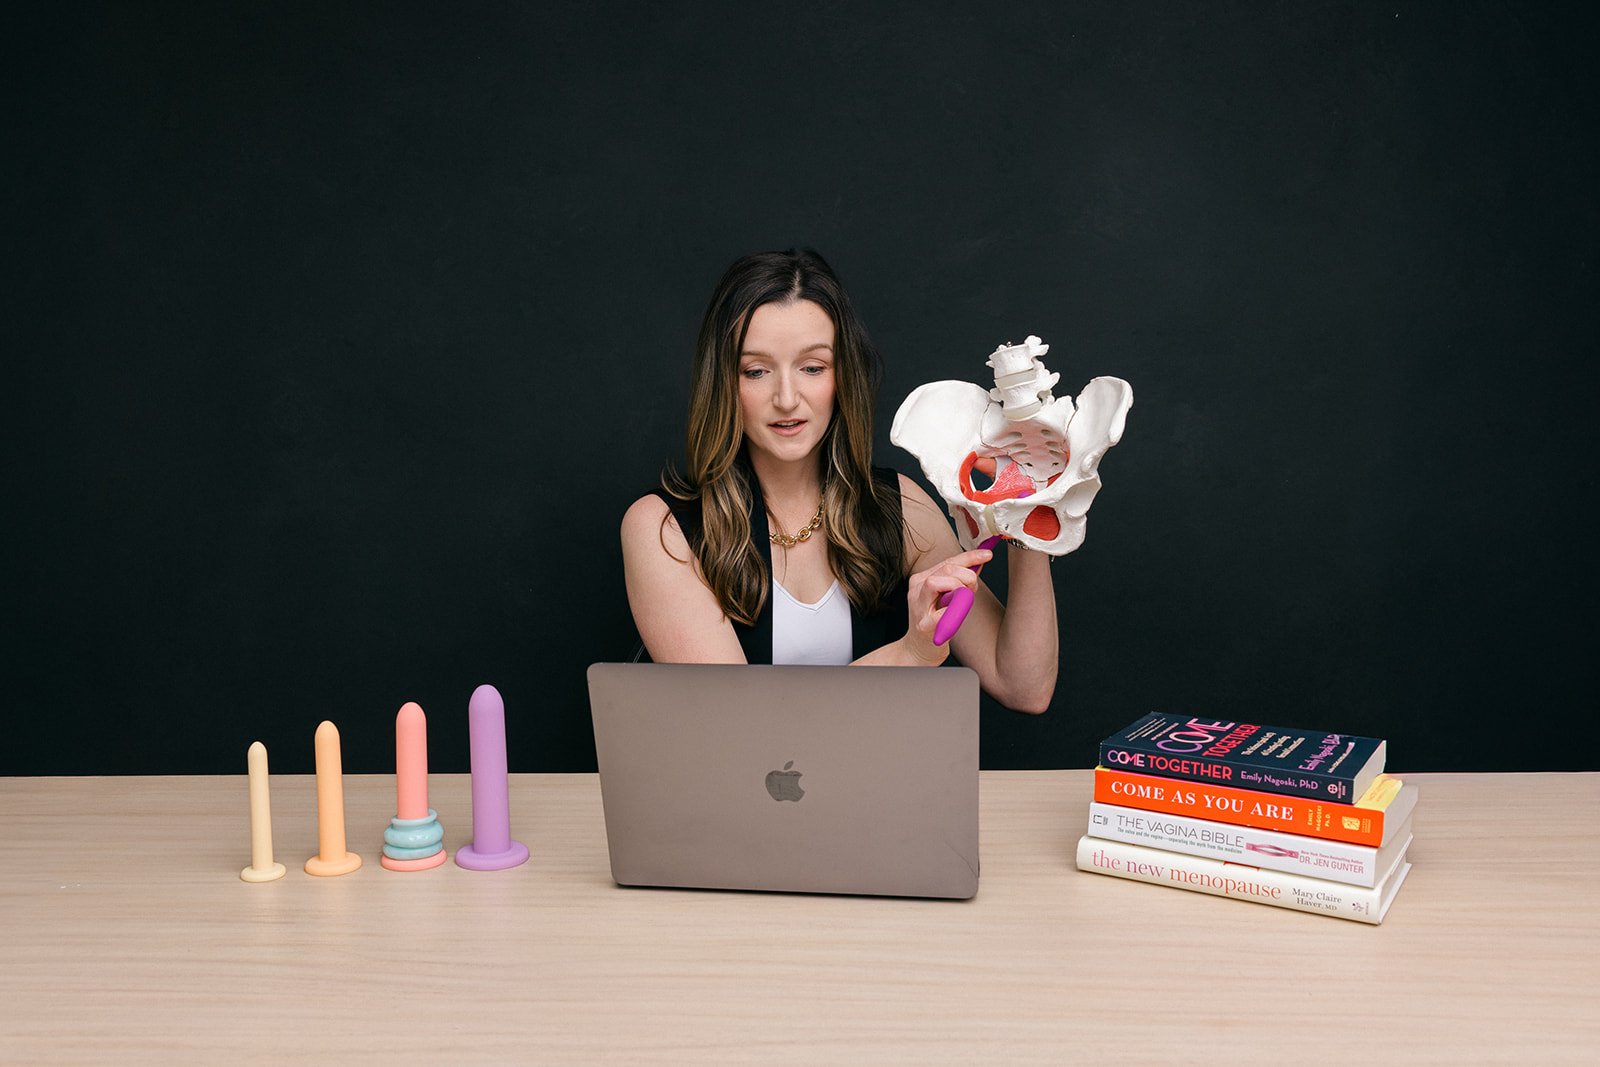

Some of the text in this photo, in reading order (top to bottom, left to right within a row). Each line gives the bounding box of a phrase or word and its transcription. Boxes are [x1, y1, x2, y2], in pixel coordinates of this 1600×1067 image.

[1202, 724, 1261, 757] TOGETHER
[1107, 750, 1319, 790] COME TOGETHER Emily Nagoski, PhD
[1111, 781, 1293, 821] COME AS YOU ARE
[1116, 815, 1144, 829] THE
[1147, 820, 1198, 839] VAGINA
[1201, 830, 1244, 848] BIBLE
[1092, 850, 1281, 899] the new menopause
[1300, 855, 1364, 874] DR. JEN GUNTER
[1292, 888, 1342, 904] Mary Claire
[1296, 898, 1324, 909] Haver,
